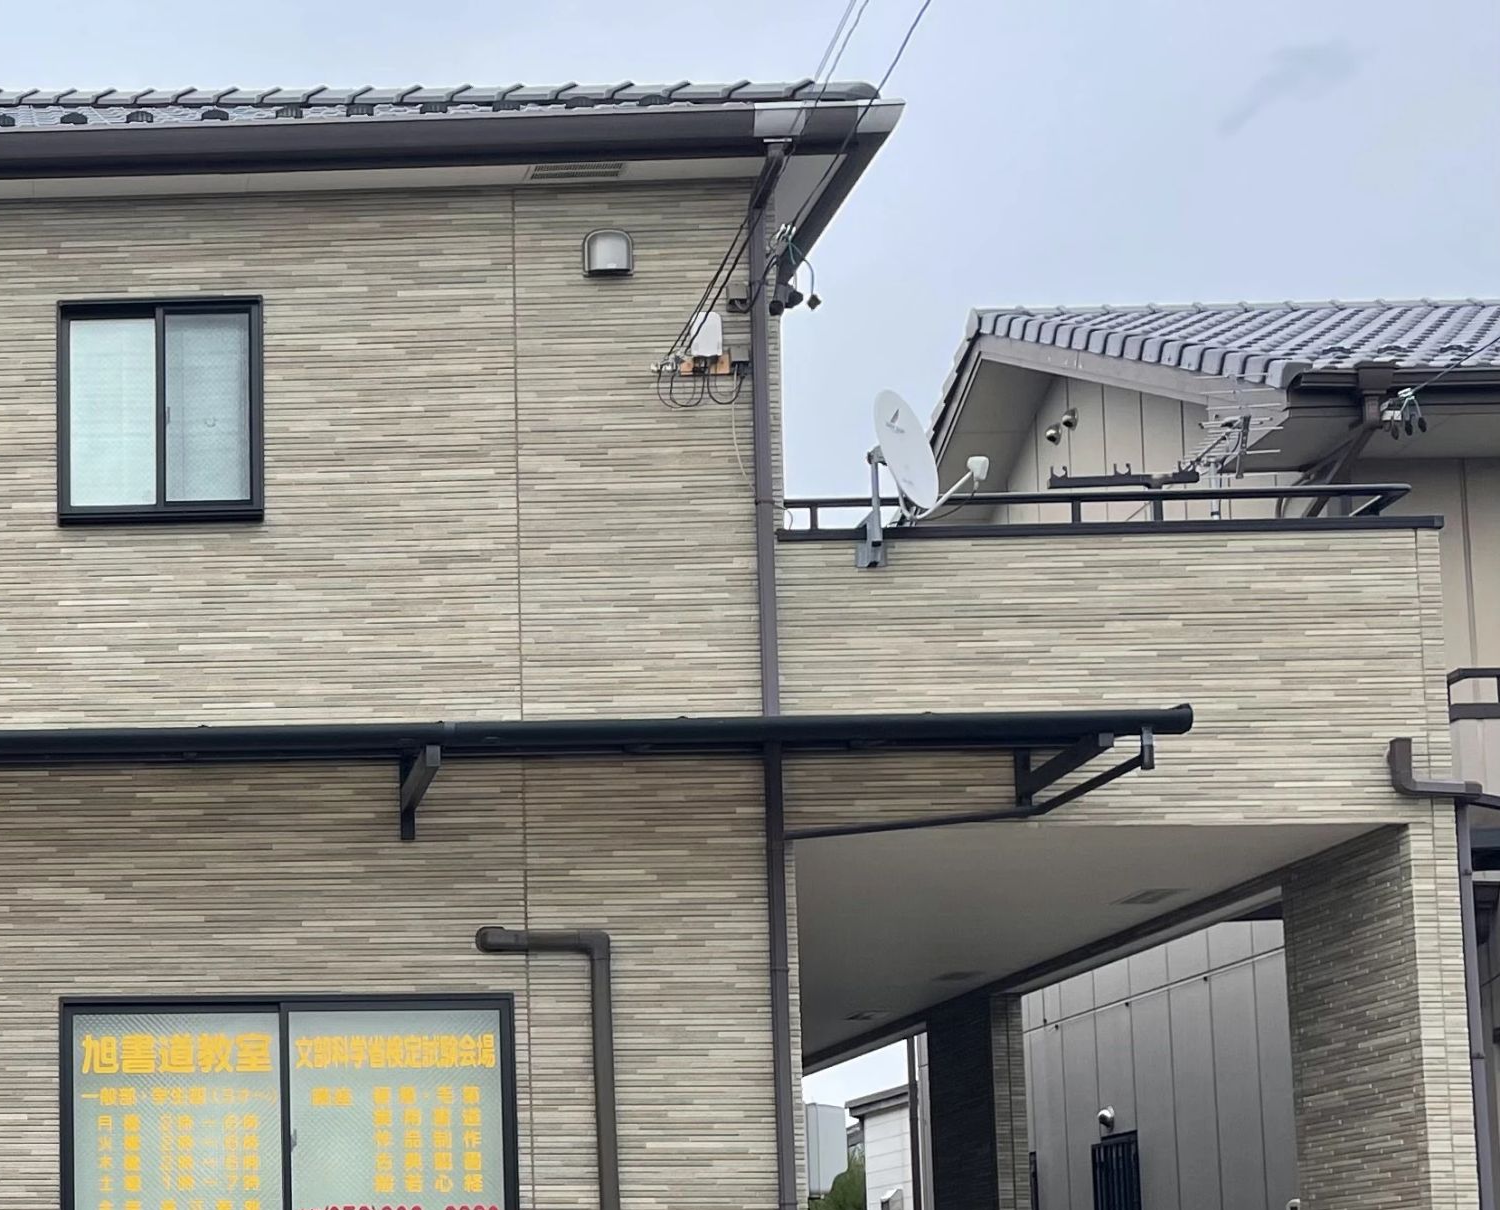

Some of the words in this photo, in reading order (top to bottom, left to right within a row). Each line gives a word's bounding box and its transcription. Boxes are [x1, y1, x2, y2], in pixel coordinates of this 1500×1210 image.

[82, 1033, 273, 1074] 旭書道教室
[295, 1034, 495, 1069] 文部科学省検定試験会場
